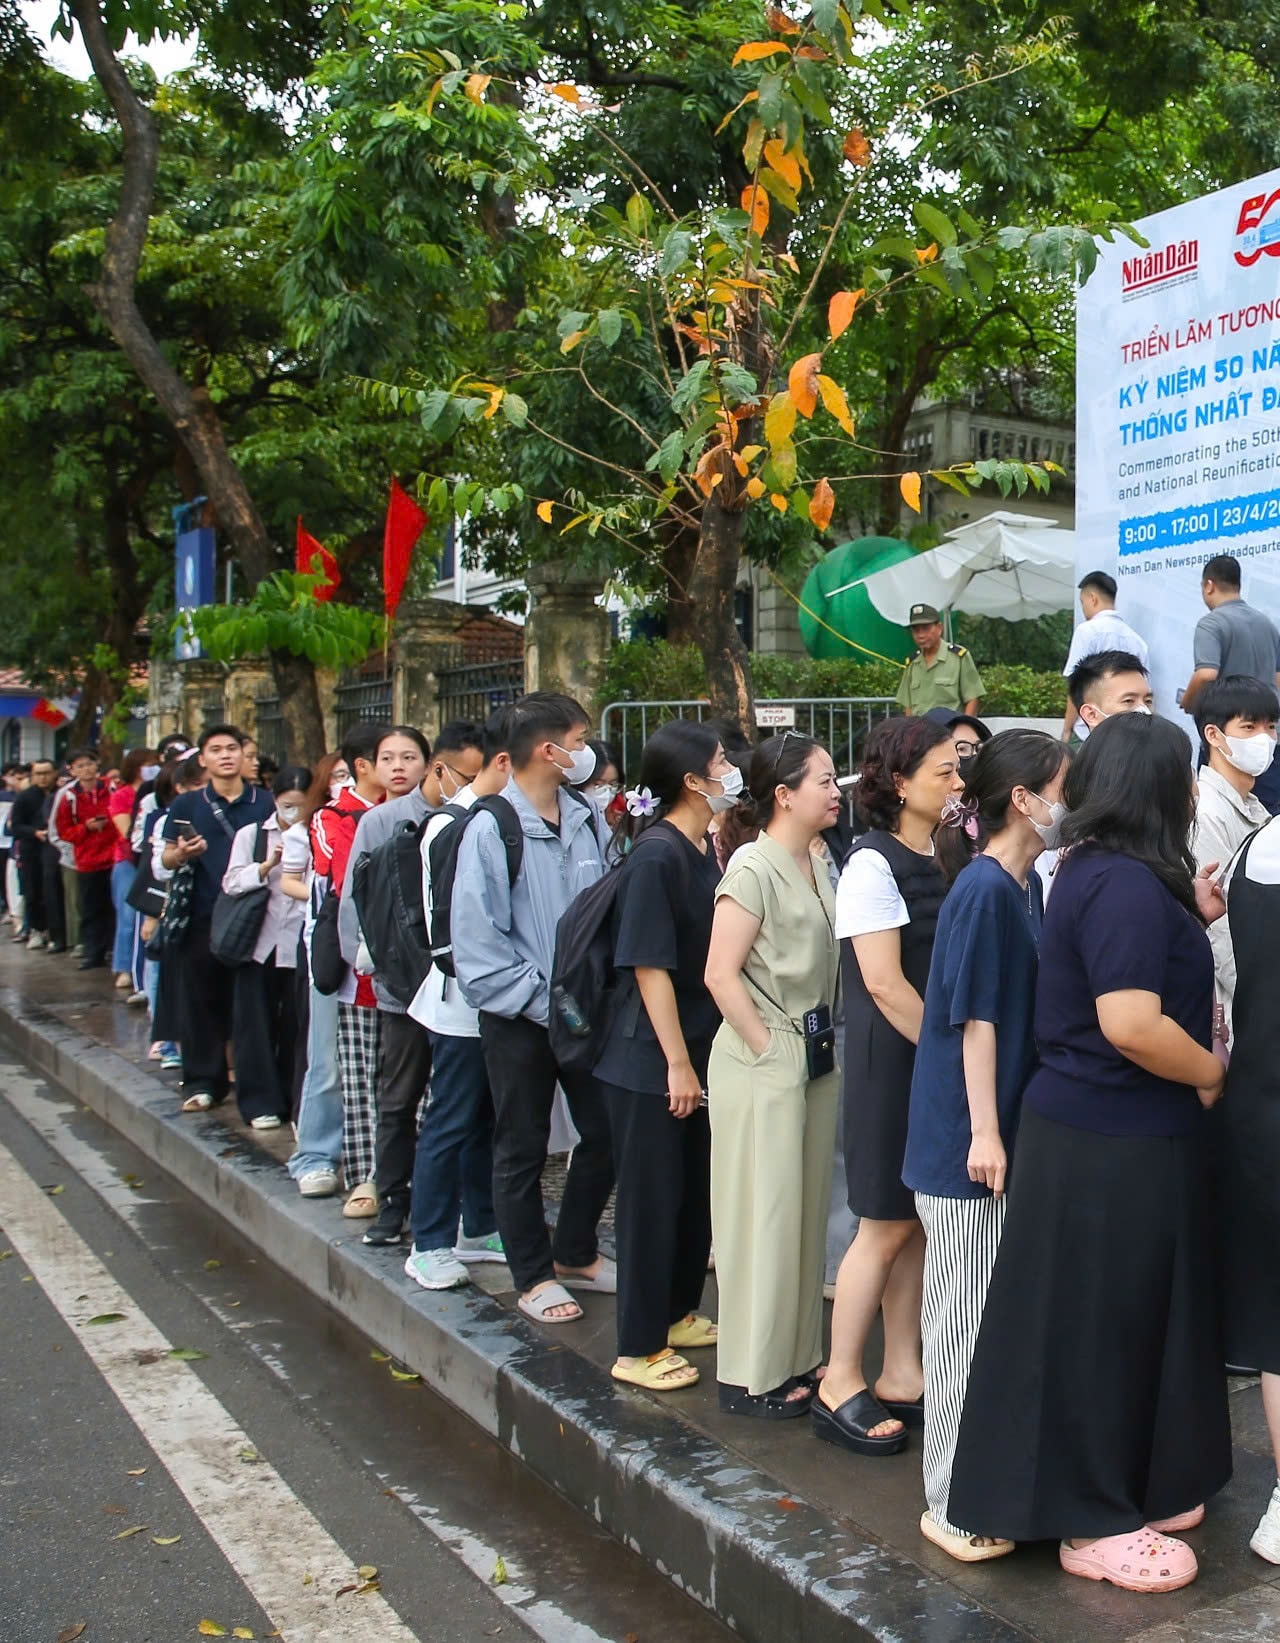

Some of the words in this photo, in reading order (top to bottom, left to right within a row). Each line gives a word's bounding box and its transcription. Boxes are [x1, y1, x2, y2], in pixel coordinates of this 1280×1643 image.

[1122, 252, 1163, 286] Nhân
[1166, 240, 1198, 271] Dân
[1121, 324, 1169, 364] TRIỂN
[1175, 319, 1212, 350] LÃM
[1120, 374, 1149, 409] KỶ
[1157, 365, 1206, 399] NIỆM
[1214, 355, 1243, 383] 50
[1119, 408, 1187, 446] THỐNG
[1195, 387, 1253, 428] NHẤT
[1118, 445, 1220, 478] Commemorating
[1226, 435, 1247, 455] the
[1118, 482, 1140, 500] and
[1144, 471, 1197, 495] National
[1124, 523, 1156, 545] 9:00
[1171, 513, 1209, 537] 17:00
[1117, 561, 1141, 577] Nhan
[1144, 557, 1163, 573] Dan
[762, 715, 787, 724] STOP
